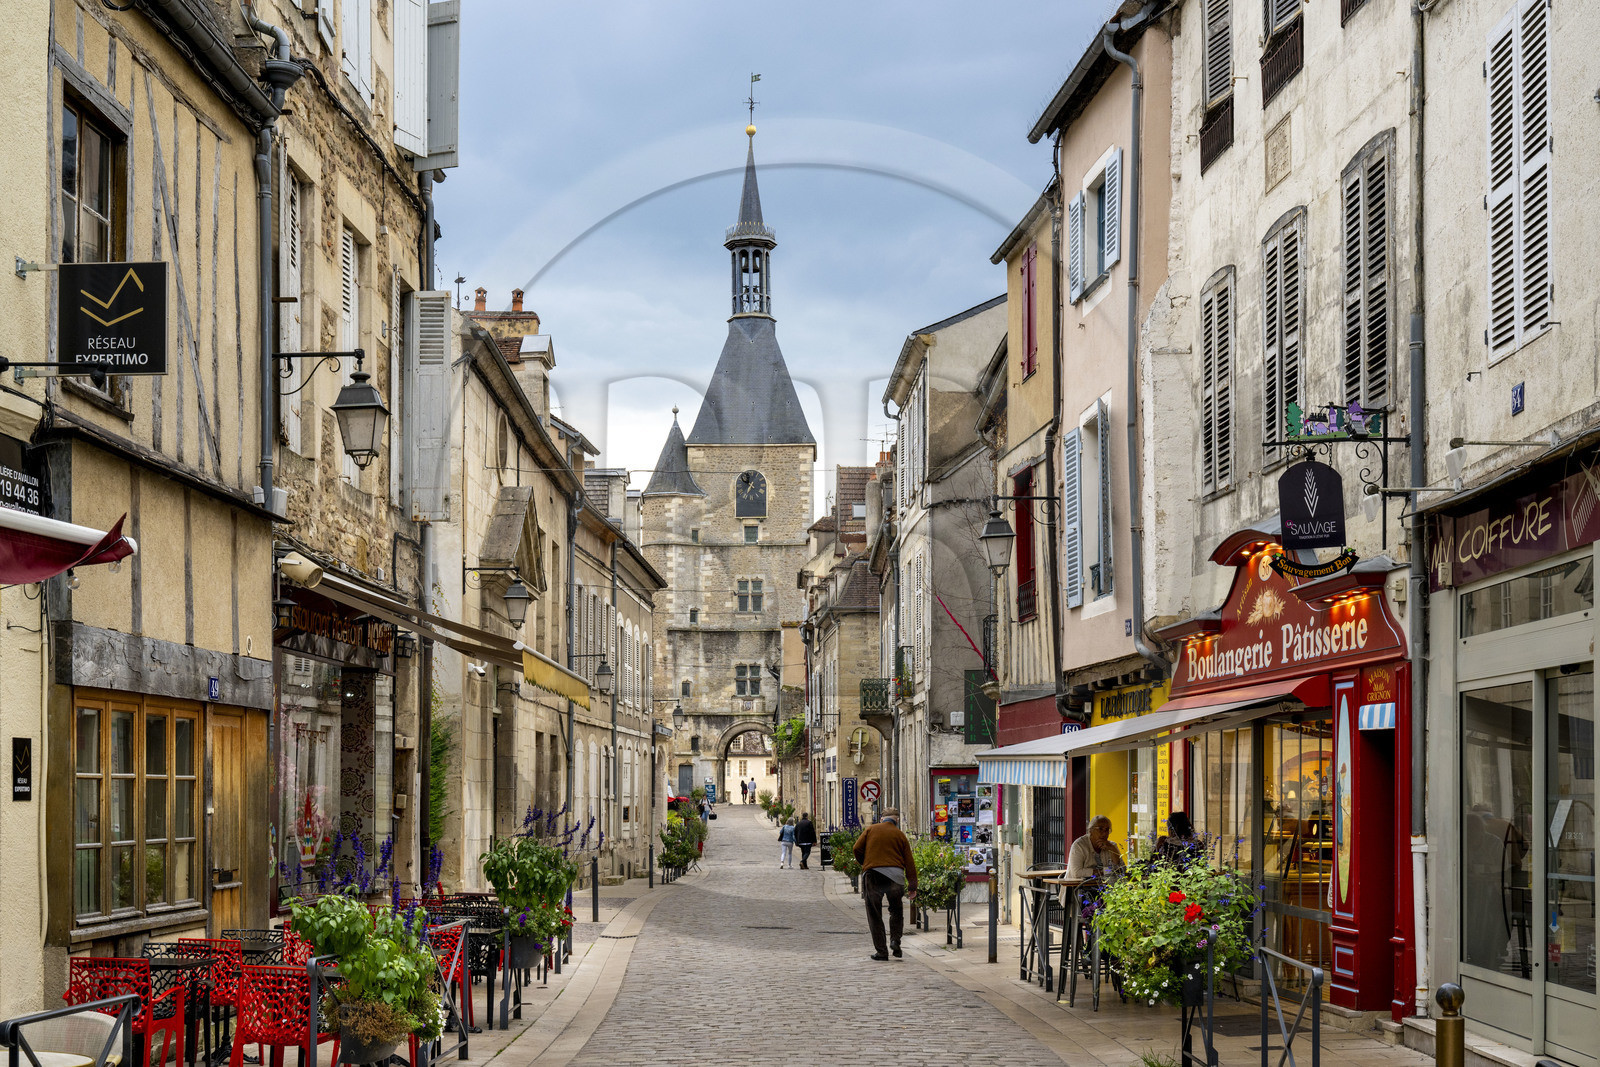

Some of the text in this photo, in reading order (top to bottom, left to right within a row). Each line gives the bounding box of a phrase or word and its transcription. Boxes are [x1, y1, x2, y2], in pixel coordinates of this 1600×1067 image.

[87, 335, 136, 350] RÉSEAU
[13, 471, 39, 488] D'AVALLON
[13, 484, 26, 502] 44
[27, 488, 39, 506] 36
[1290, 521, 1337, 535] SAUVAGE
[1458, 497, 1553, 564] COIFFURE
[1277, 556, 1353, 579] Sauvagement Bon
[1187, 605, 1368, 682] Boulangerie Pâtisserie
[1368, 668, 1390, 687] MAISON
[210, 680, 219, 697] 49
[1366, 690, 1391, 702] GRIGNON
